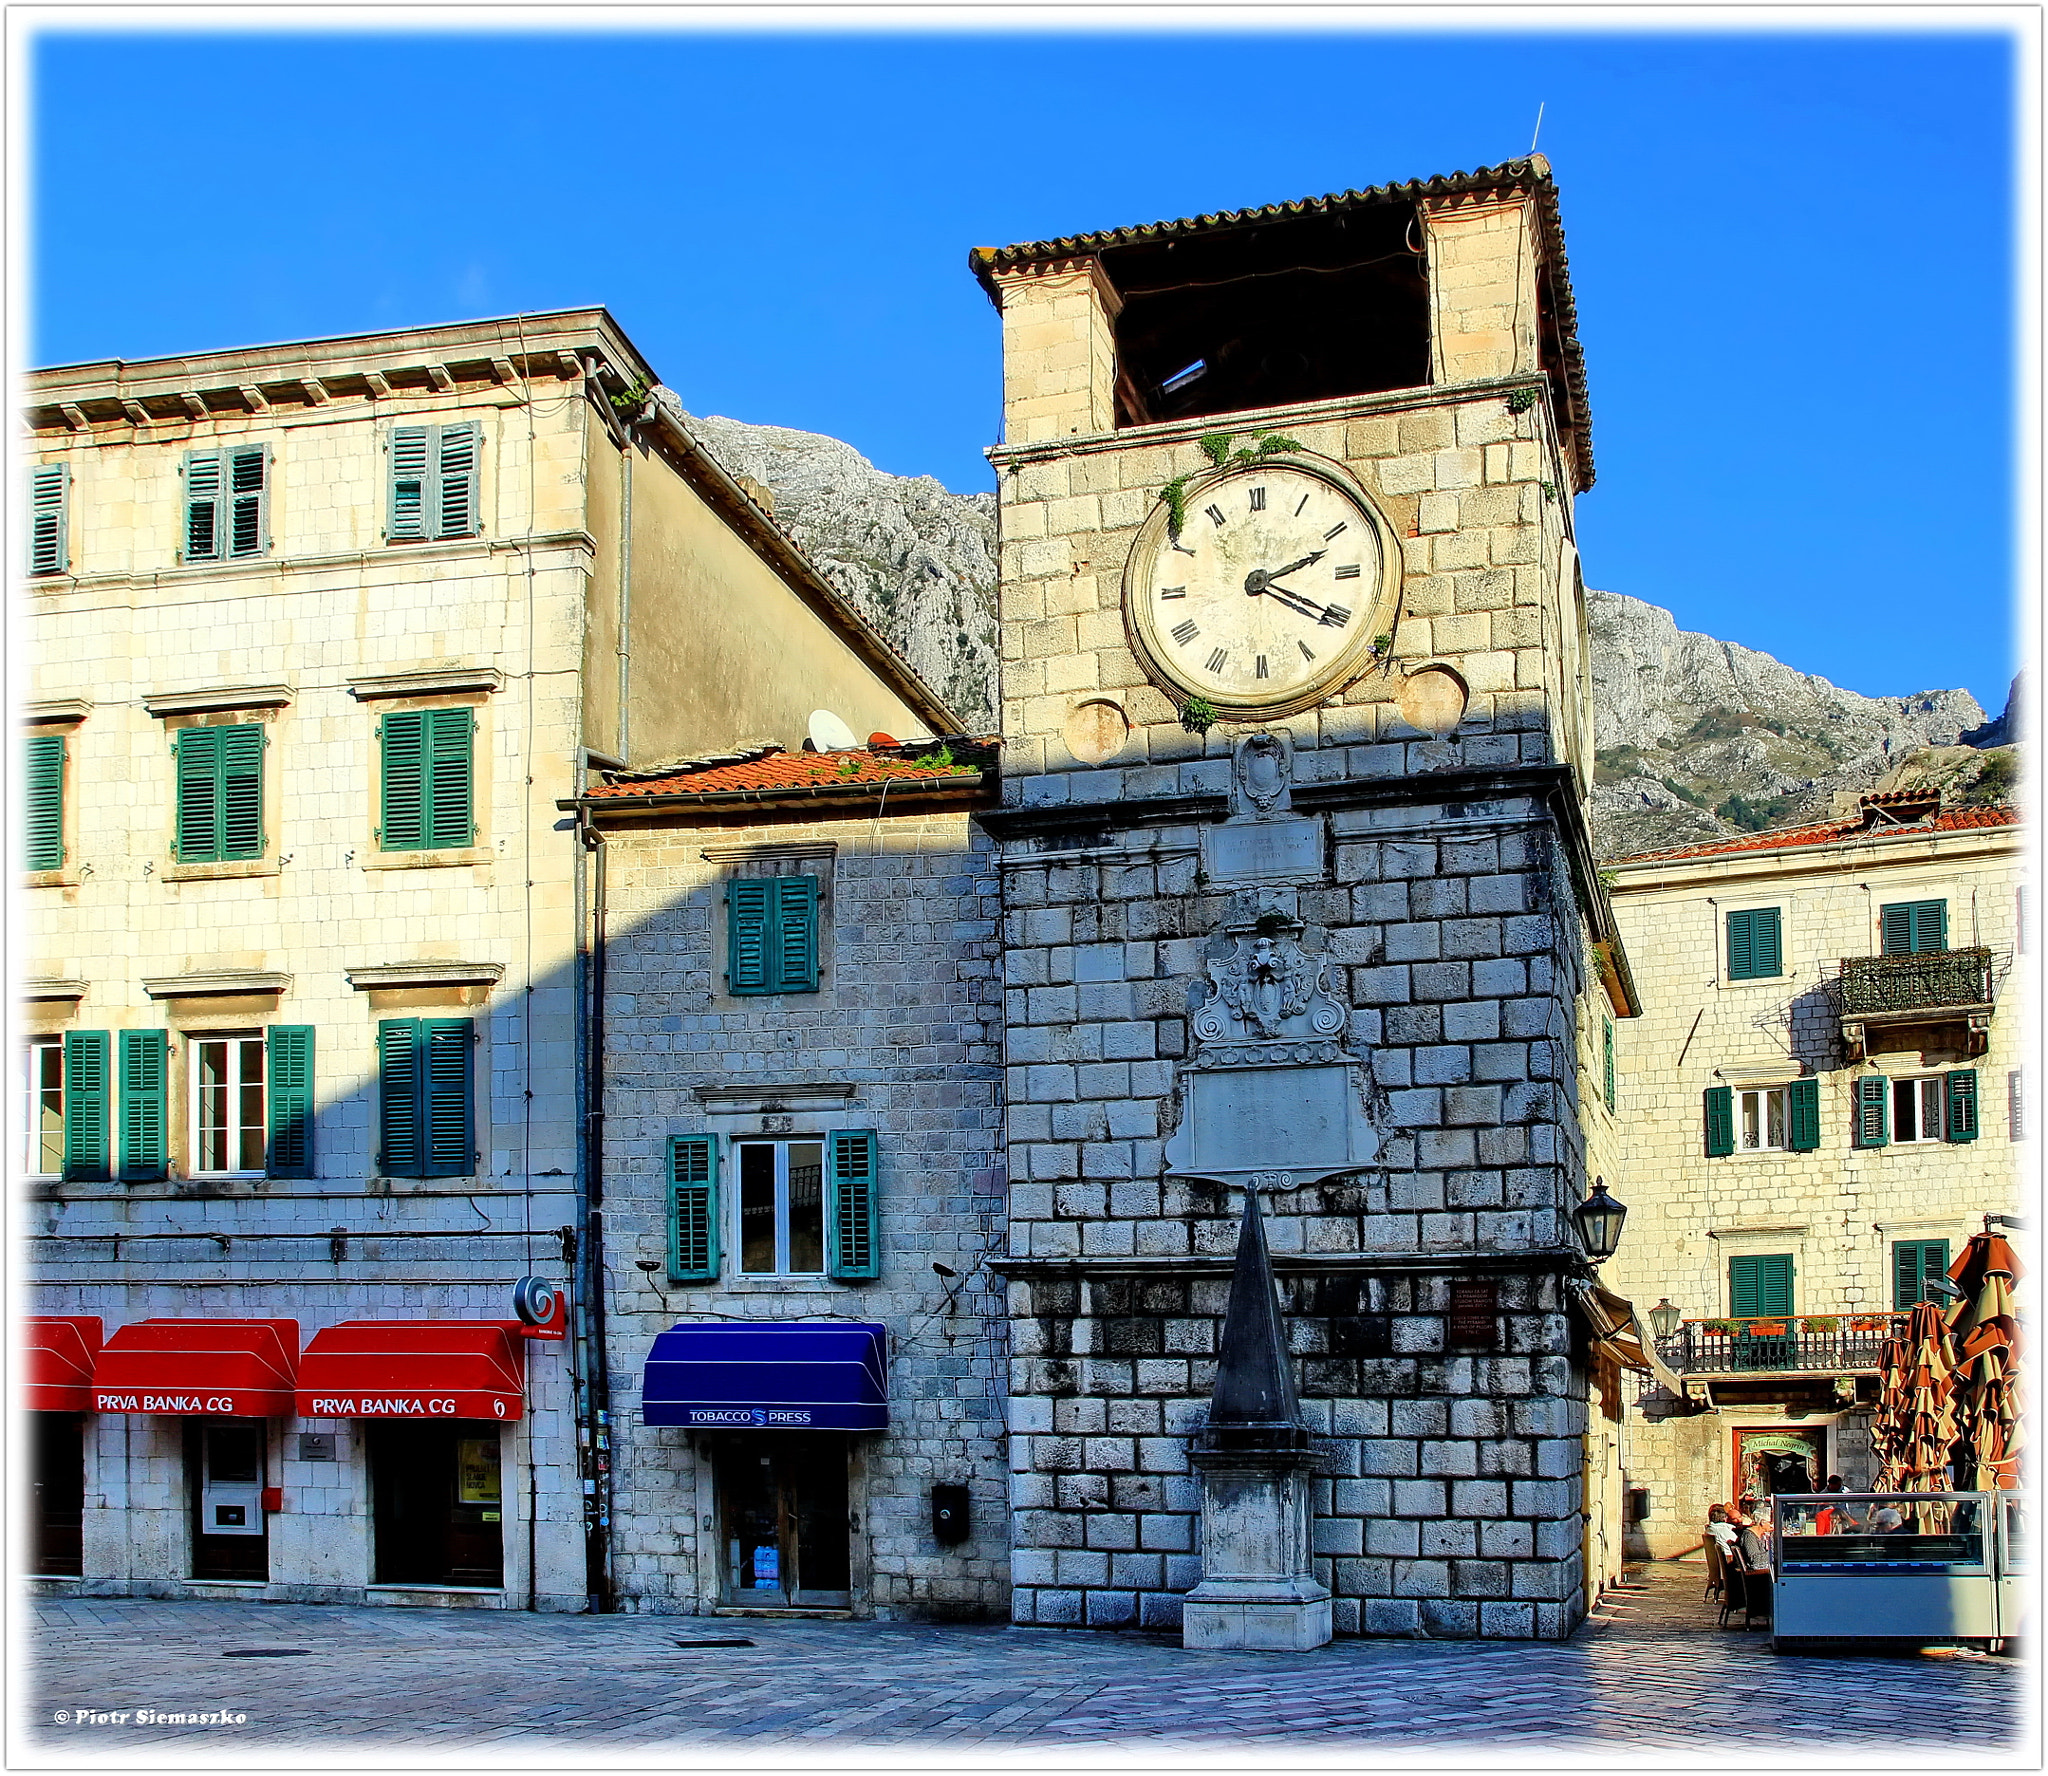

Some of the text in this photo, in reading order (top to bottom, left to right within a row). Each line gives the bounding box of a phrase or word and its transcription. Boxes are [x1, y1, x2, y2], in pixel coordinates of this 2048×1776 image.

[97, 1395, 233, 1411] PRVA BANKA CG
[312, 1399, 456, 1413] PRVA BANKA CG
[689, 1411, 751, 1421] TOBACCO
[768, 1412, 811, 1422] PRESS
[1752, 1438, 1805, 1450] Michal Negrin
